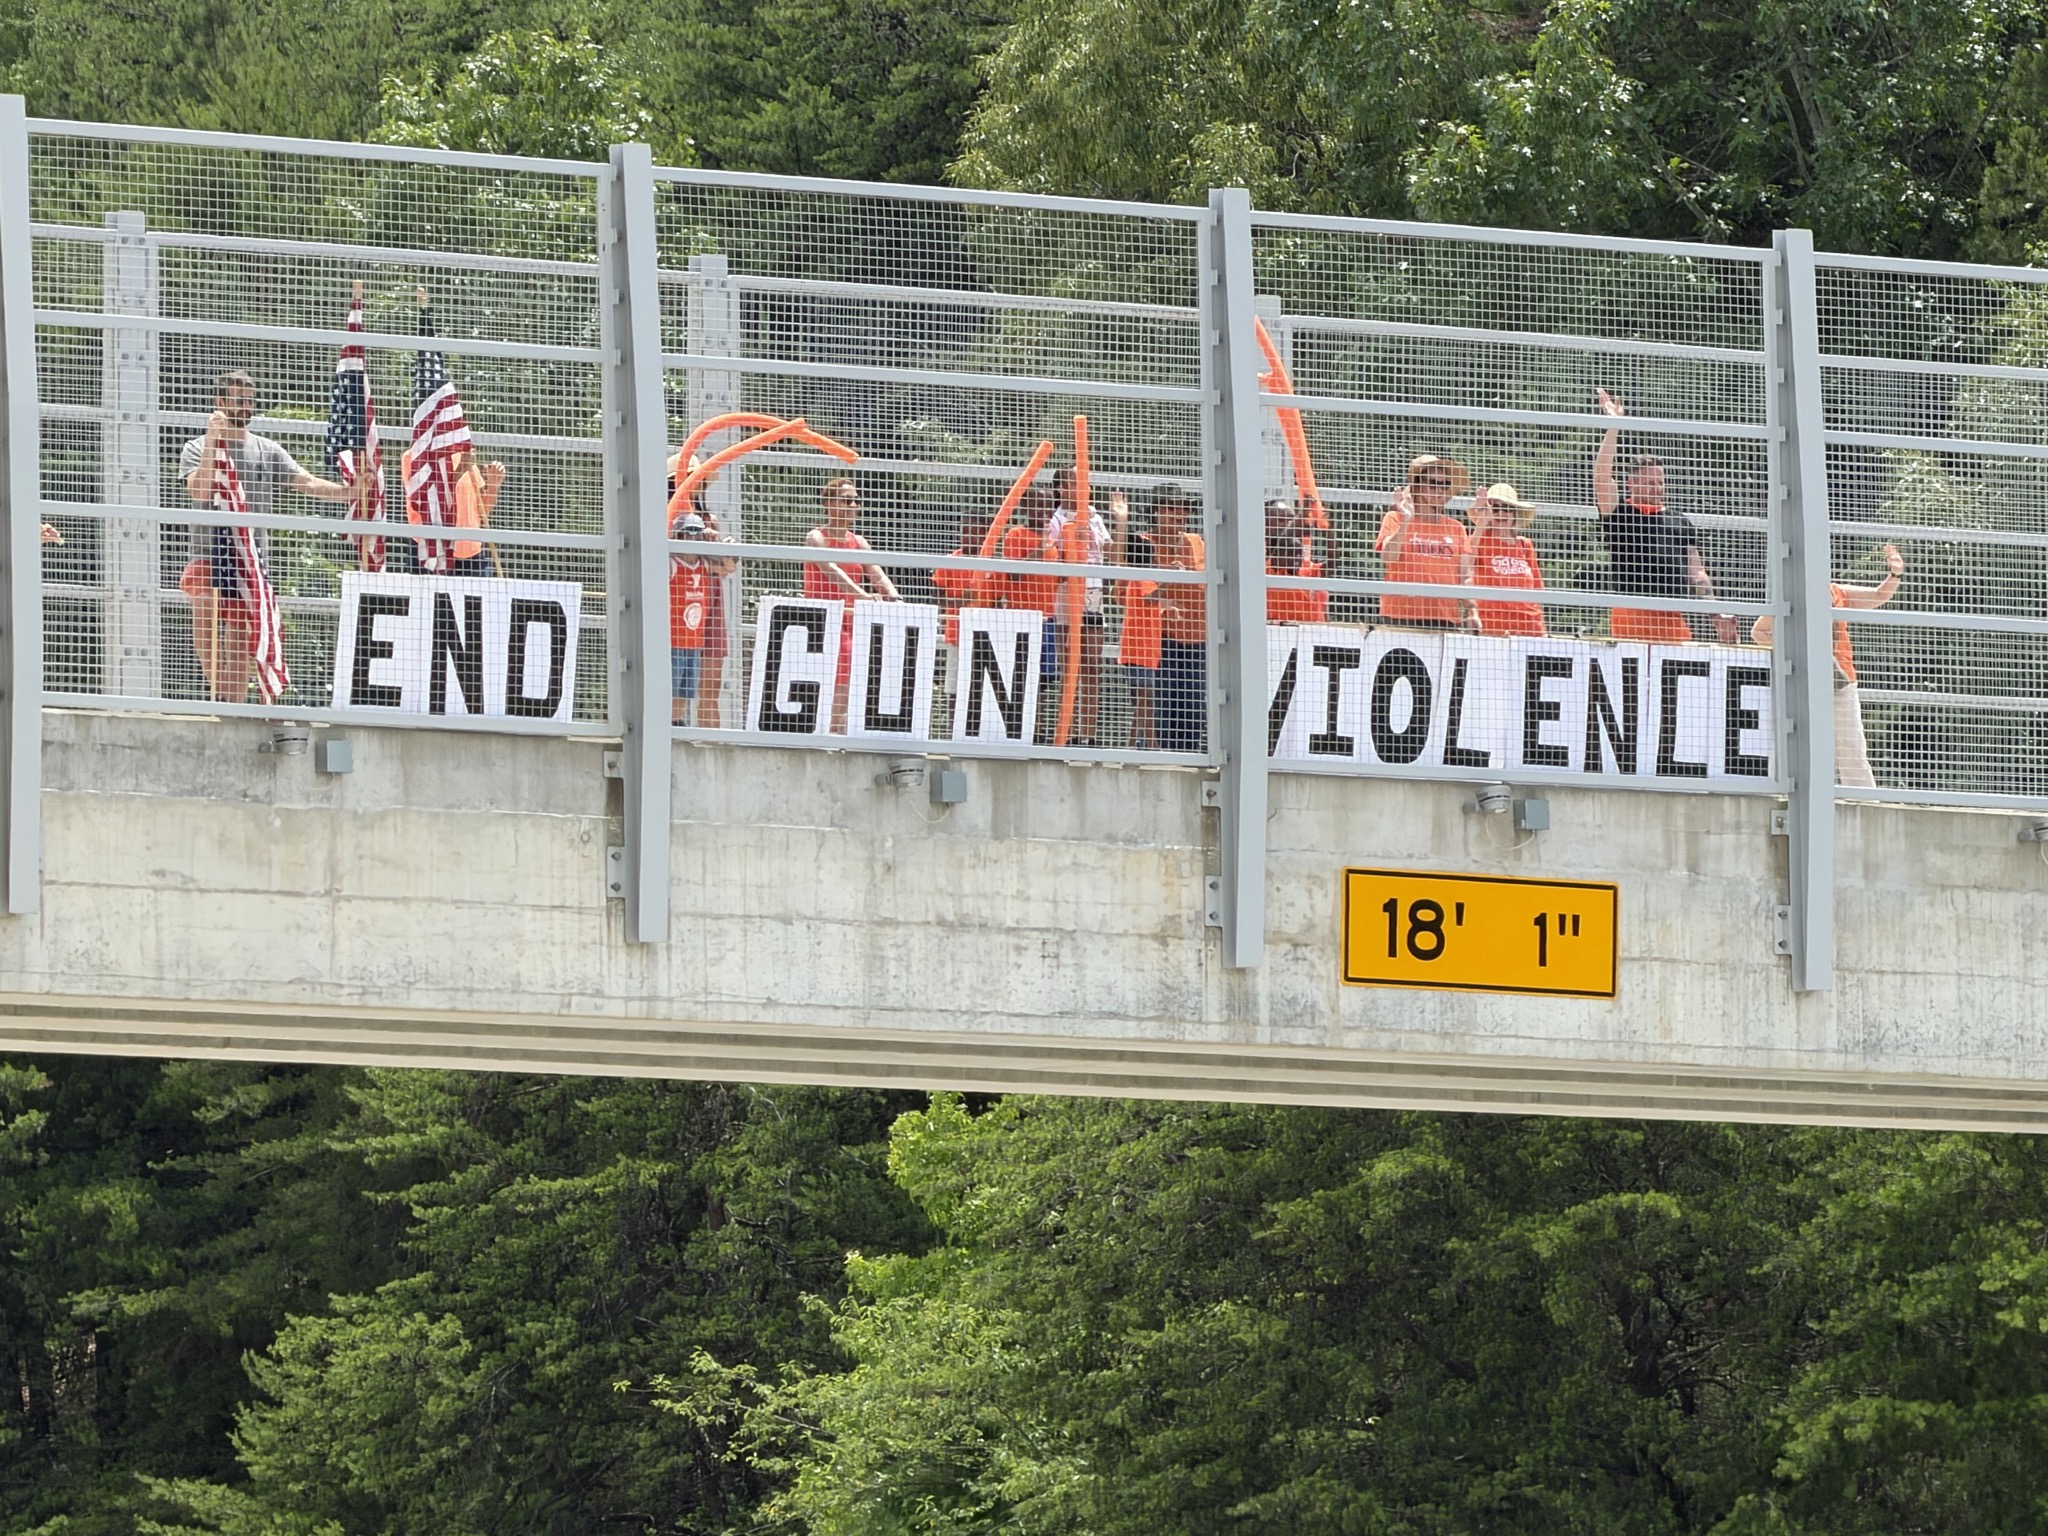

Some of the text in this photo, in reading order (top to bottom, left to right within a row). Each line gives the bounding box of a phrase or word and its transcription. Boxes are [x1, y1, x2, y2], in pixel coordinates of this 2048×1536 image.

[350, 592, 567, 718] END
[758, 605, 1029, 740] GUN
[1382, 898, 1581, 968] 18' 1"
